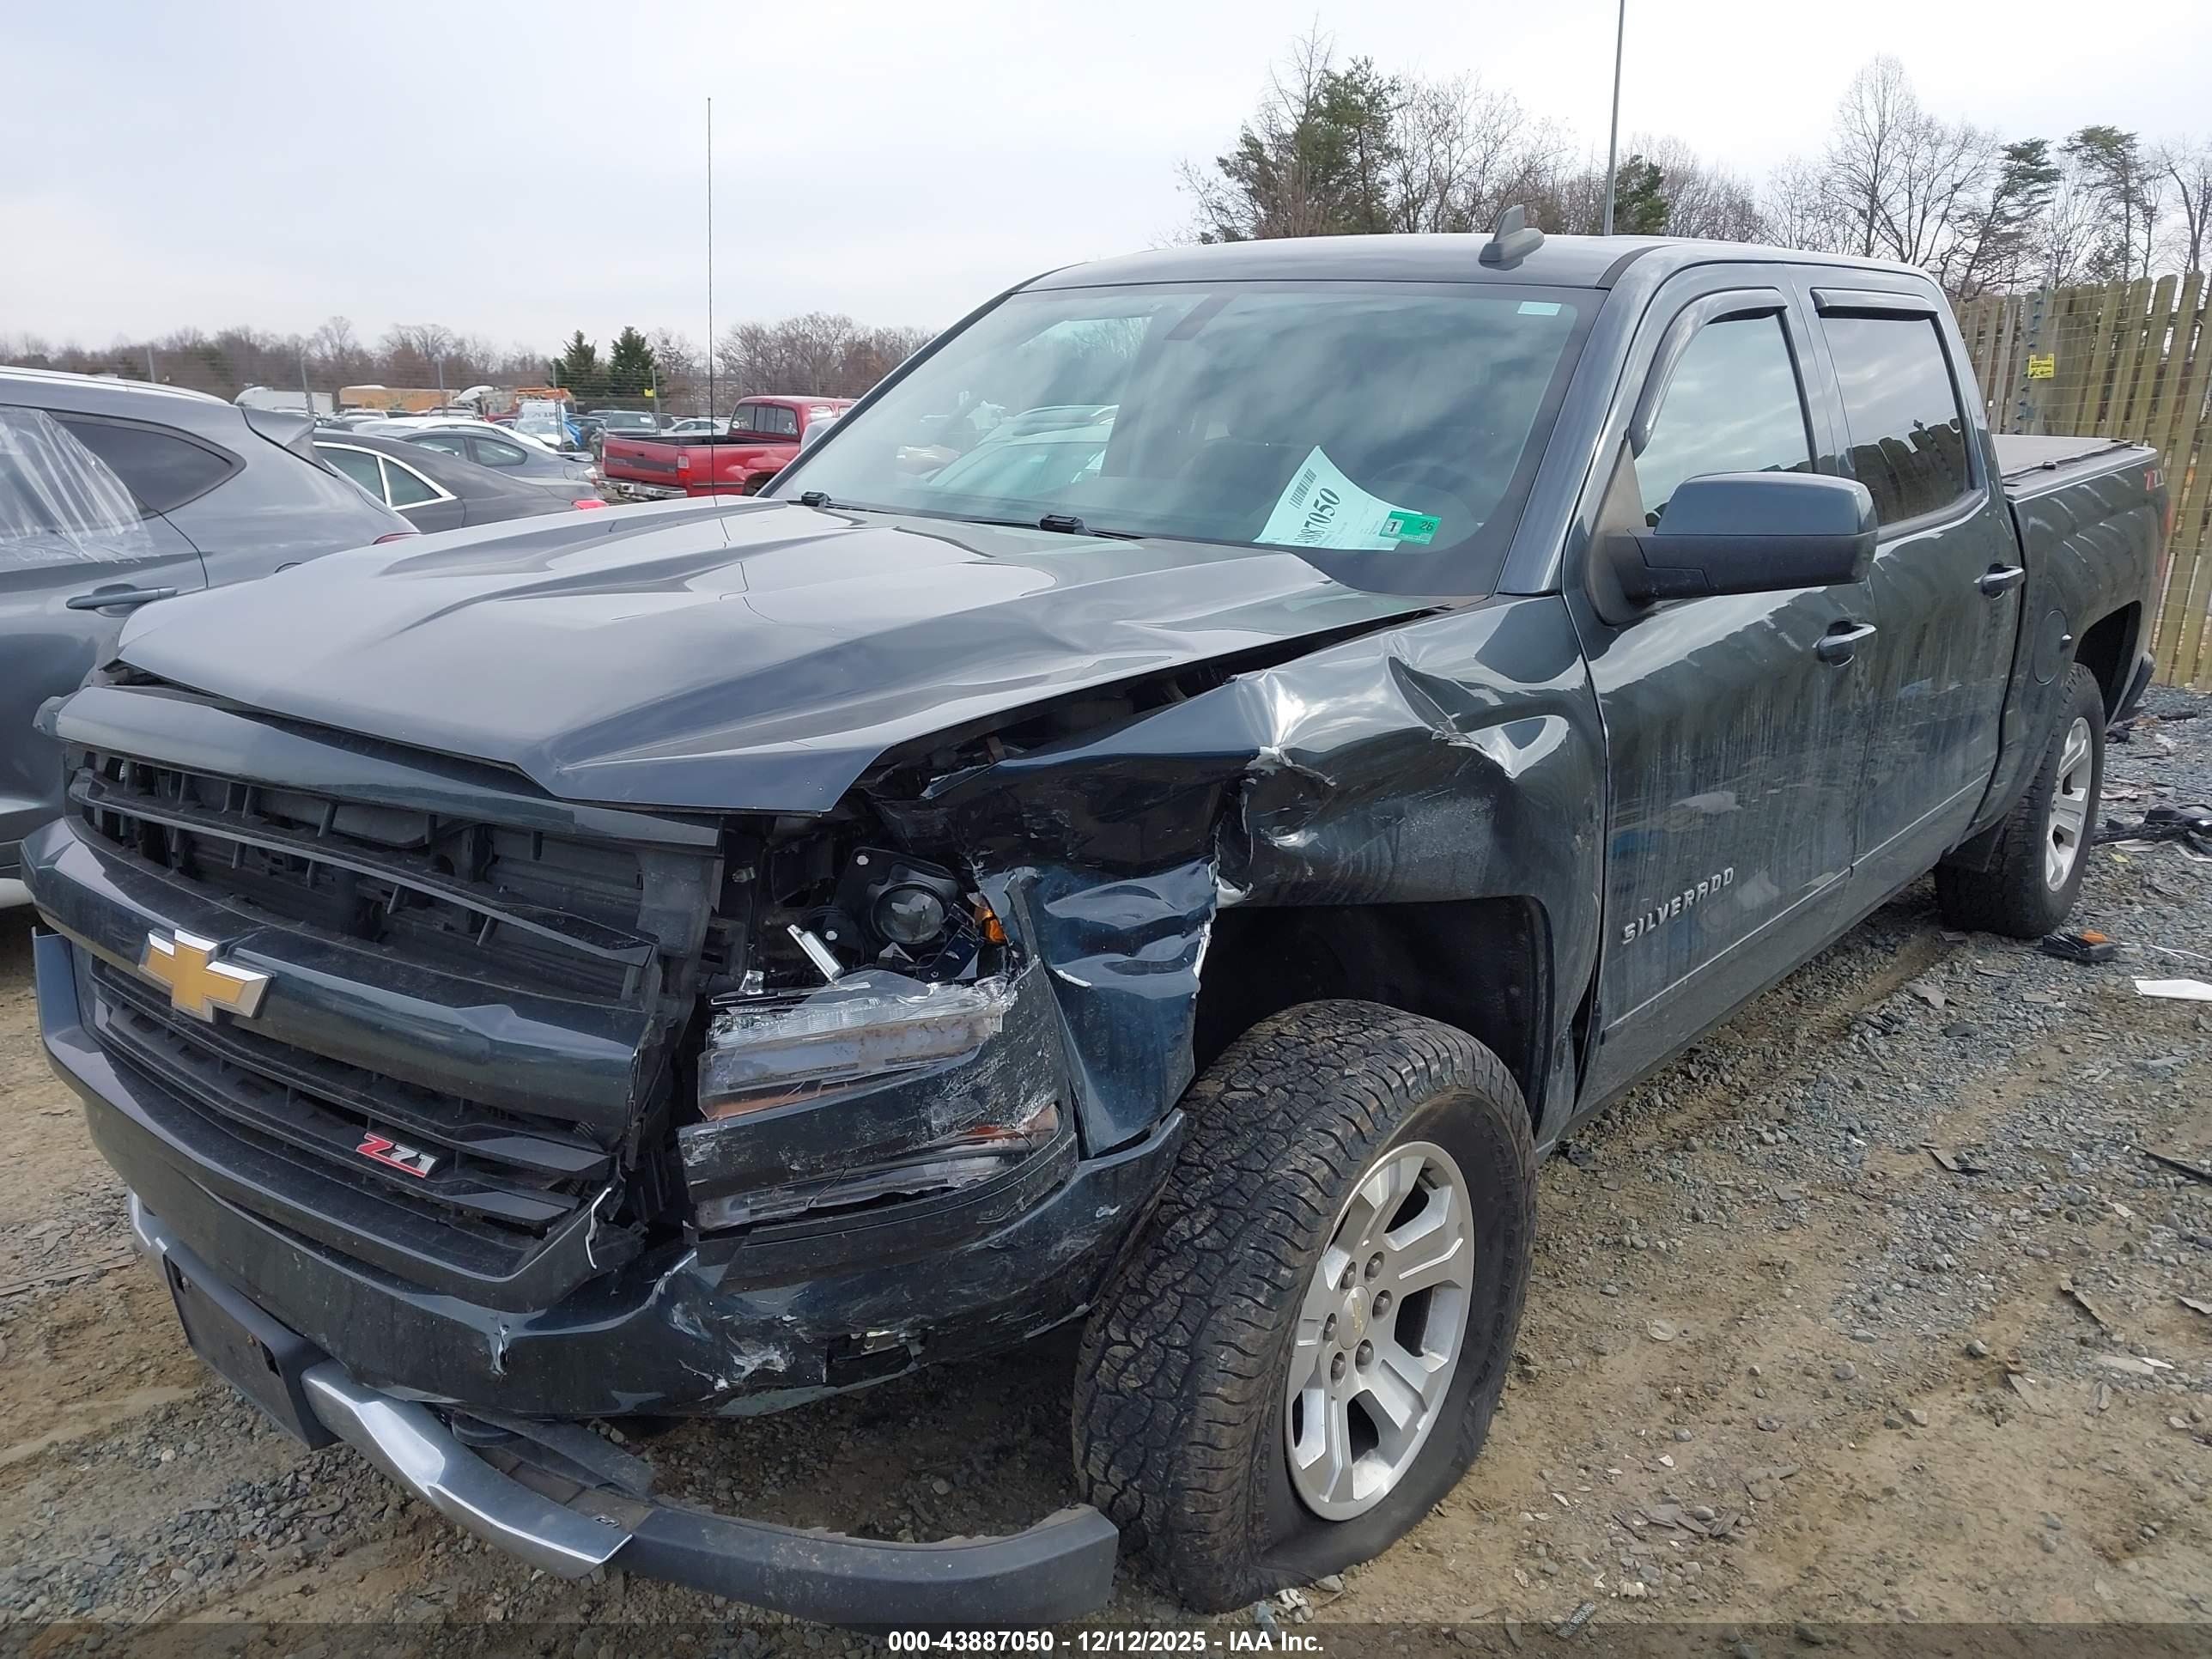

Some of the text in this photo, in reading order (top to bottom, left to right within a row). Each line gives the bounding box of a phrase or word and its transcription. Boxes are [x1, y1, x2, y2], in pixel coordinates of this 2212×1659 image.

[1388, 520, 1435, 533] 1 26
[1621, 866, 1735, 945] SILVERADO
[356, 1131, 439, 1178] Z71
